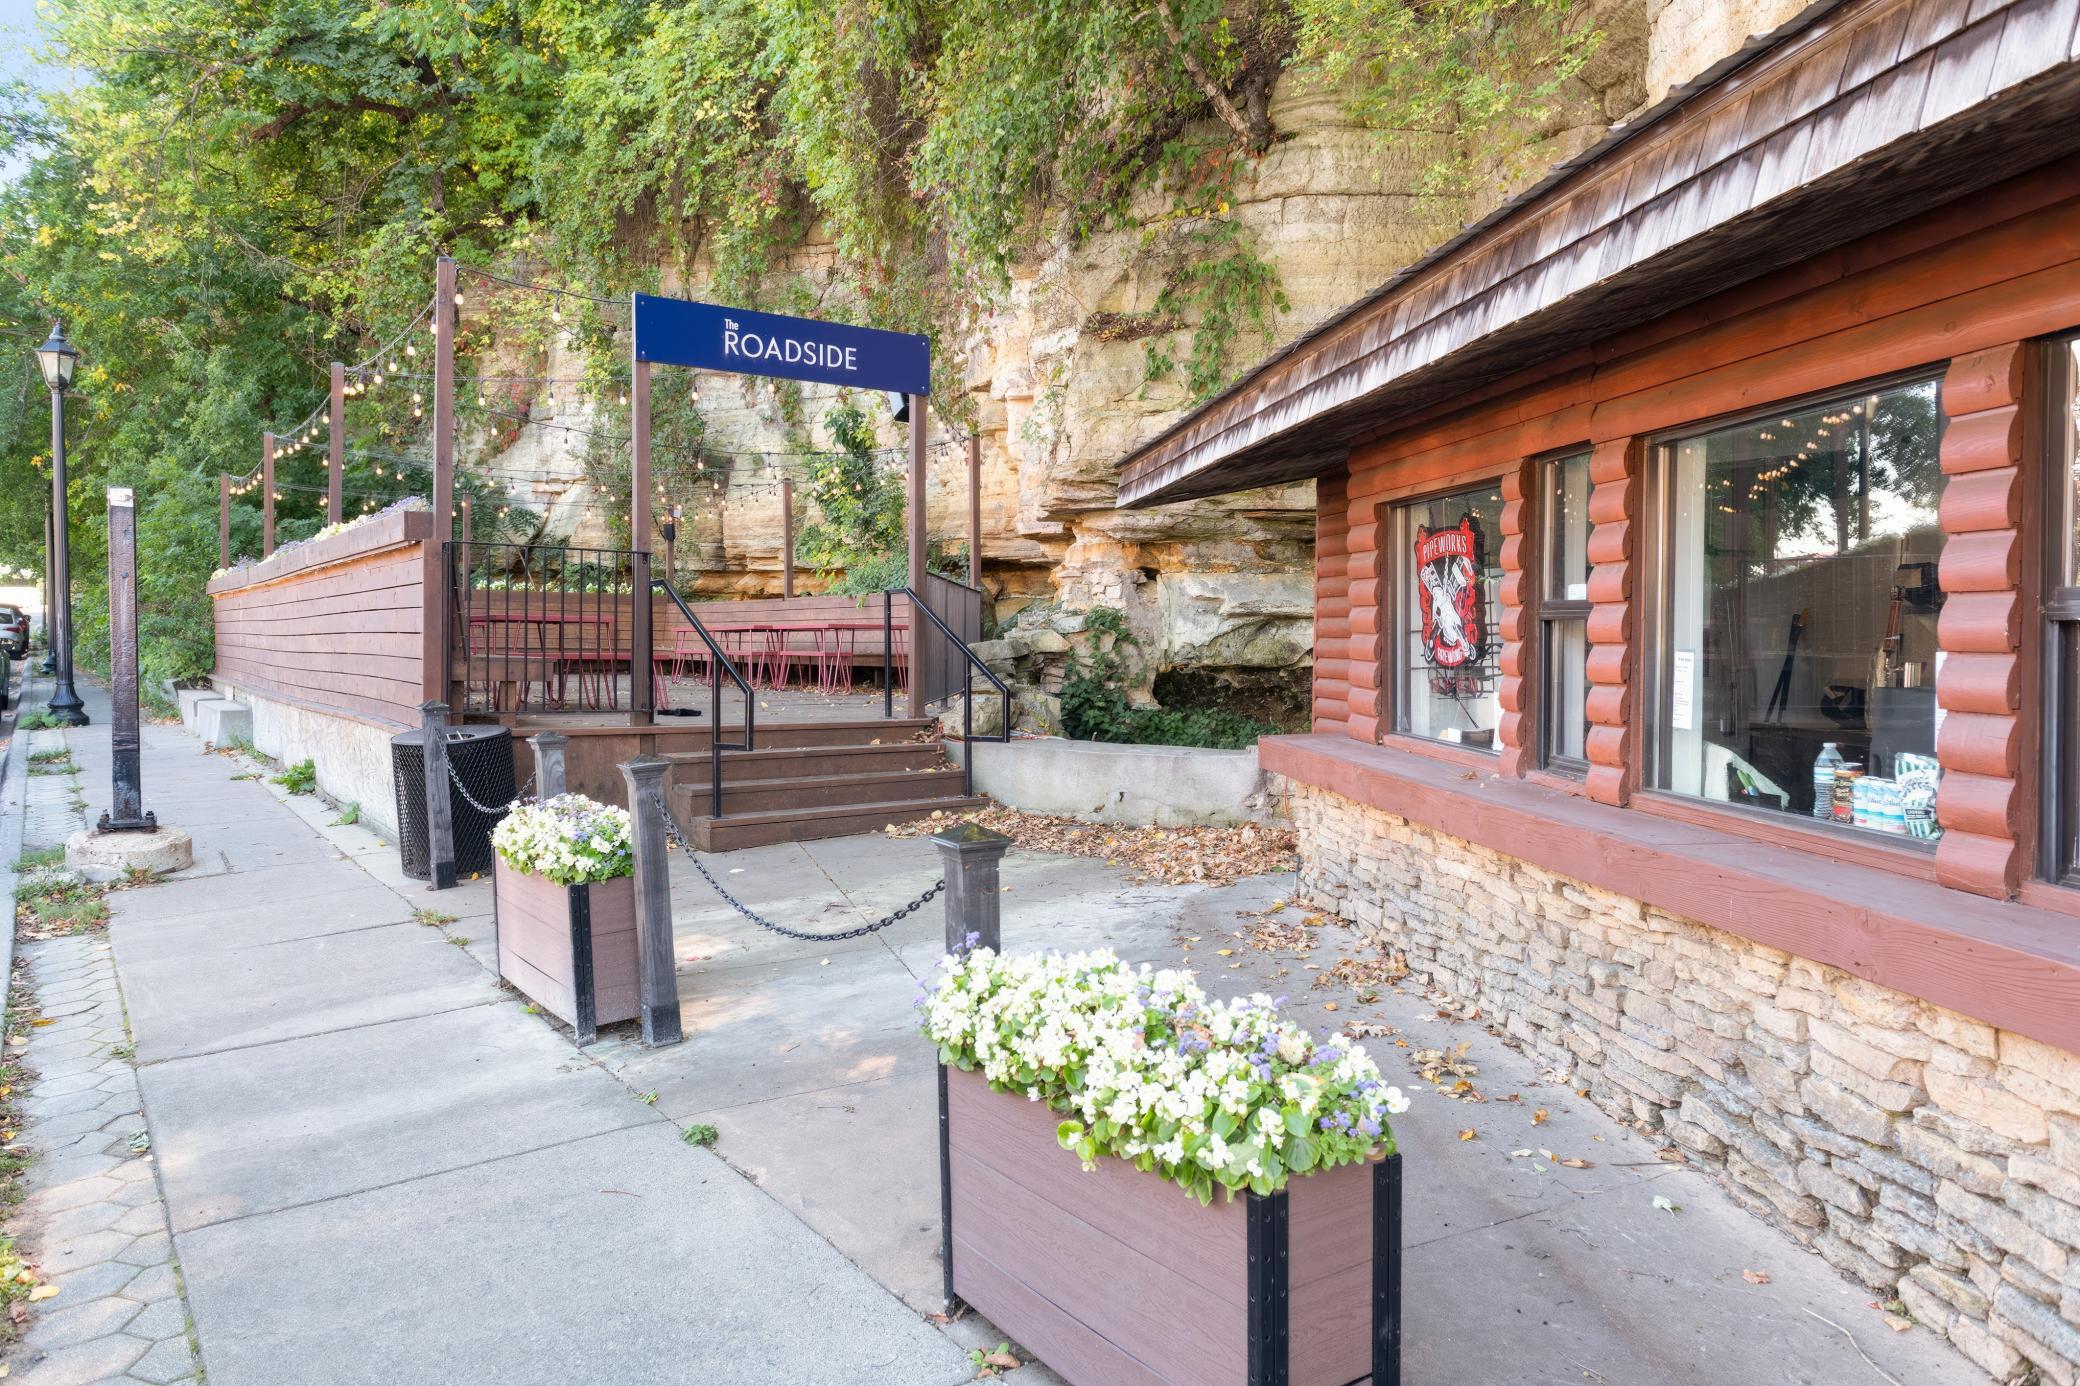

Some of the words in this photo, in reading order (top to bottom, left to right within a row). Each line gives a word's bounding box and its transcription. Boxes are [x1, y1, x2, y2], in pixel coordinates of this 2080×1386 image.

[724, 318, 738, 330] The
[724, 331, 857, 370] ROADSIDE
[1423, 534, 1467, 561] PIPEWORKS
[1437, 646, 1463, 664] BREWING
